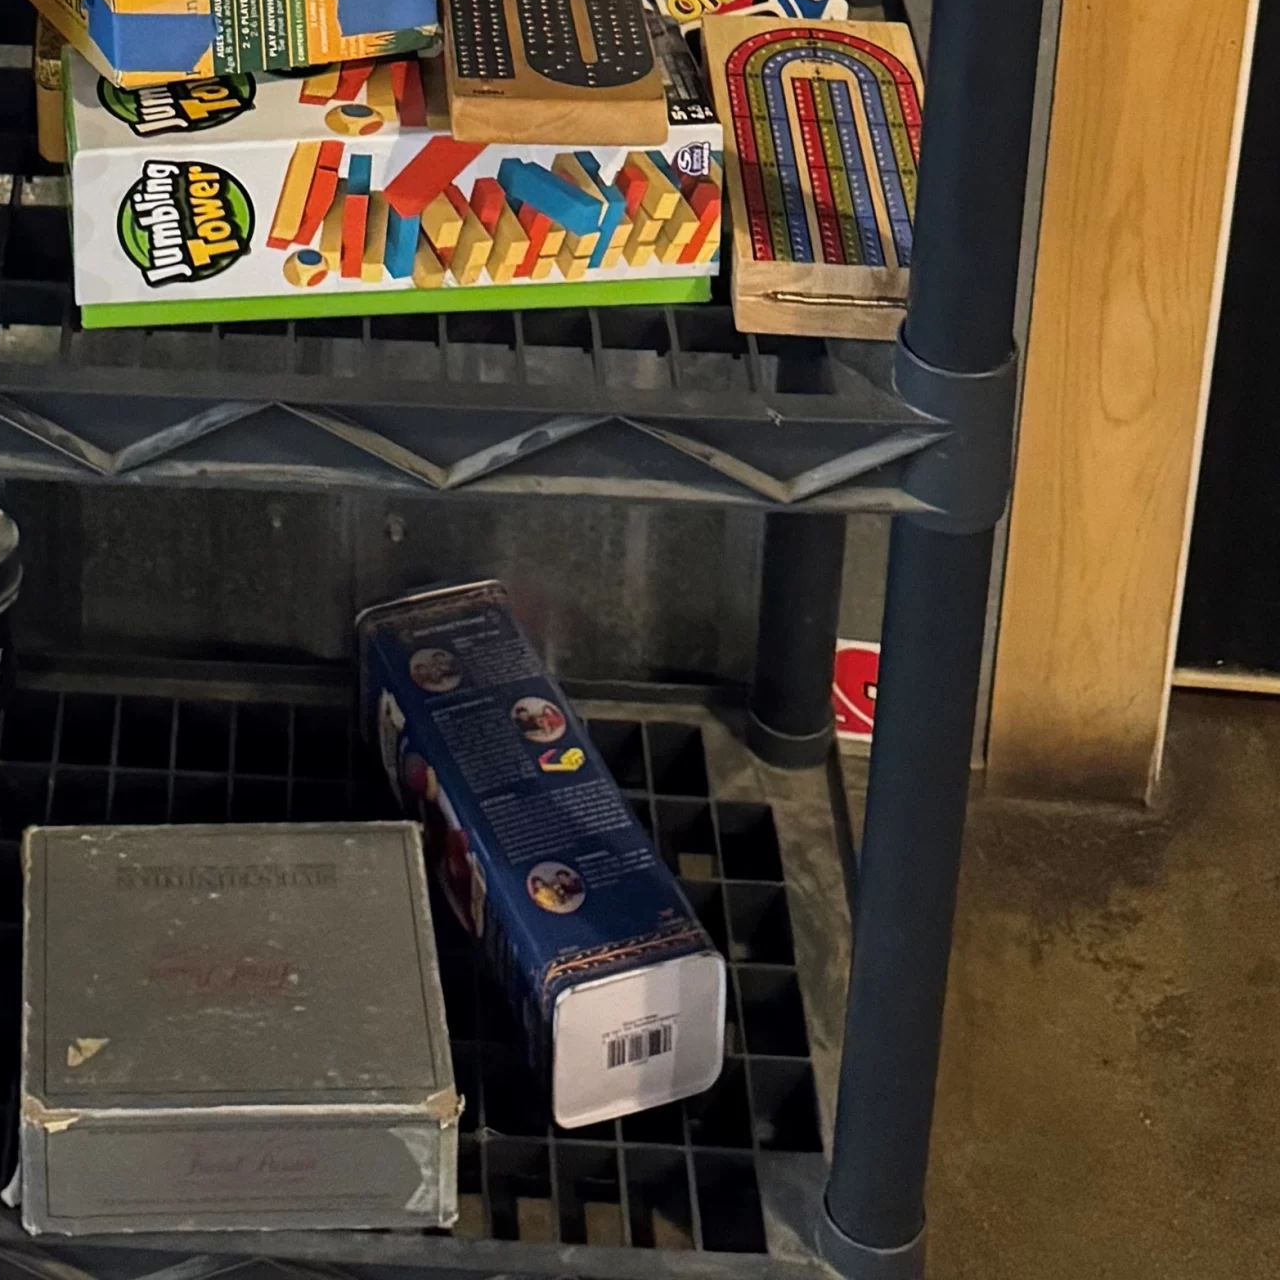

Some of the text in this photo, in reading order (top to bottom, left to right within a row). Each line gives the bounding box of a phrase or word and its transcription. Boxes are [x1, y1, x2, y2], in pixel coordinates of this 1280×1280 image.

[241, 26, 250, 35] 6
[216, 34, 225, 57] AGES
[242, 41, 250, 50] 2
[268, 34, 278, 57] PLAY
[295, 23, 305, 62] CONTENTS
[133, 163, 193, 282] Jumbling
[186, 166, 240, 267] Tower
